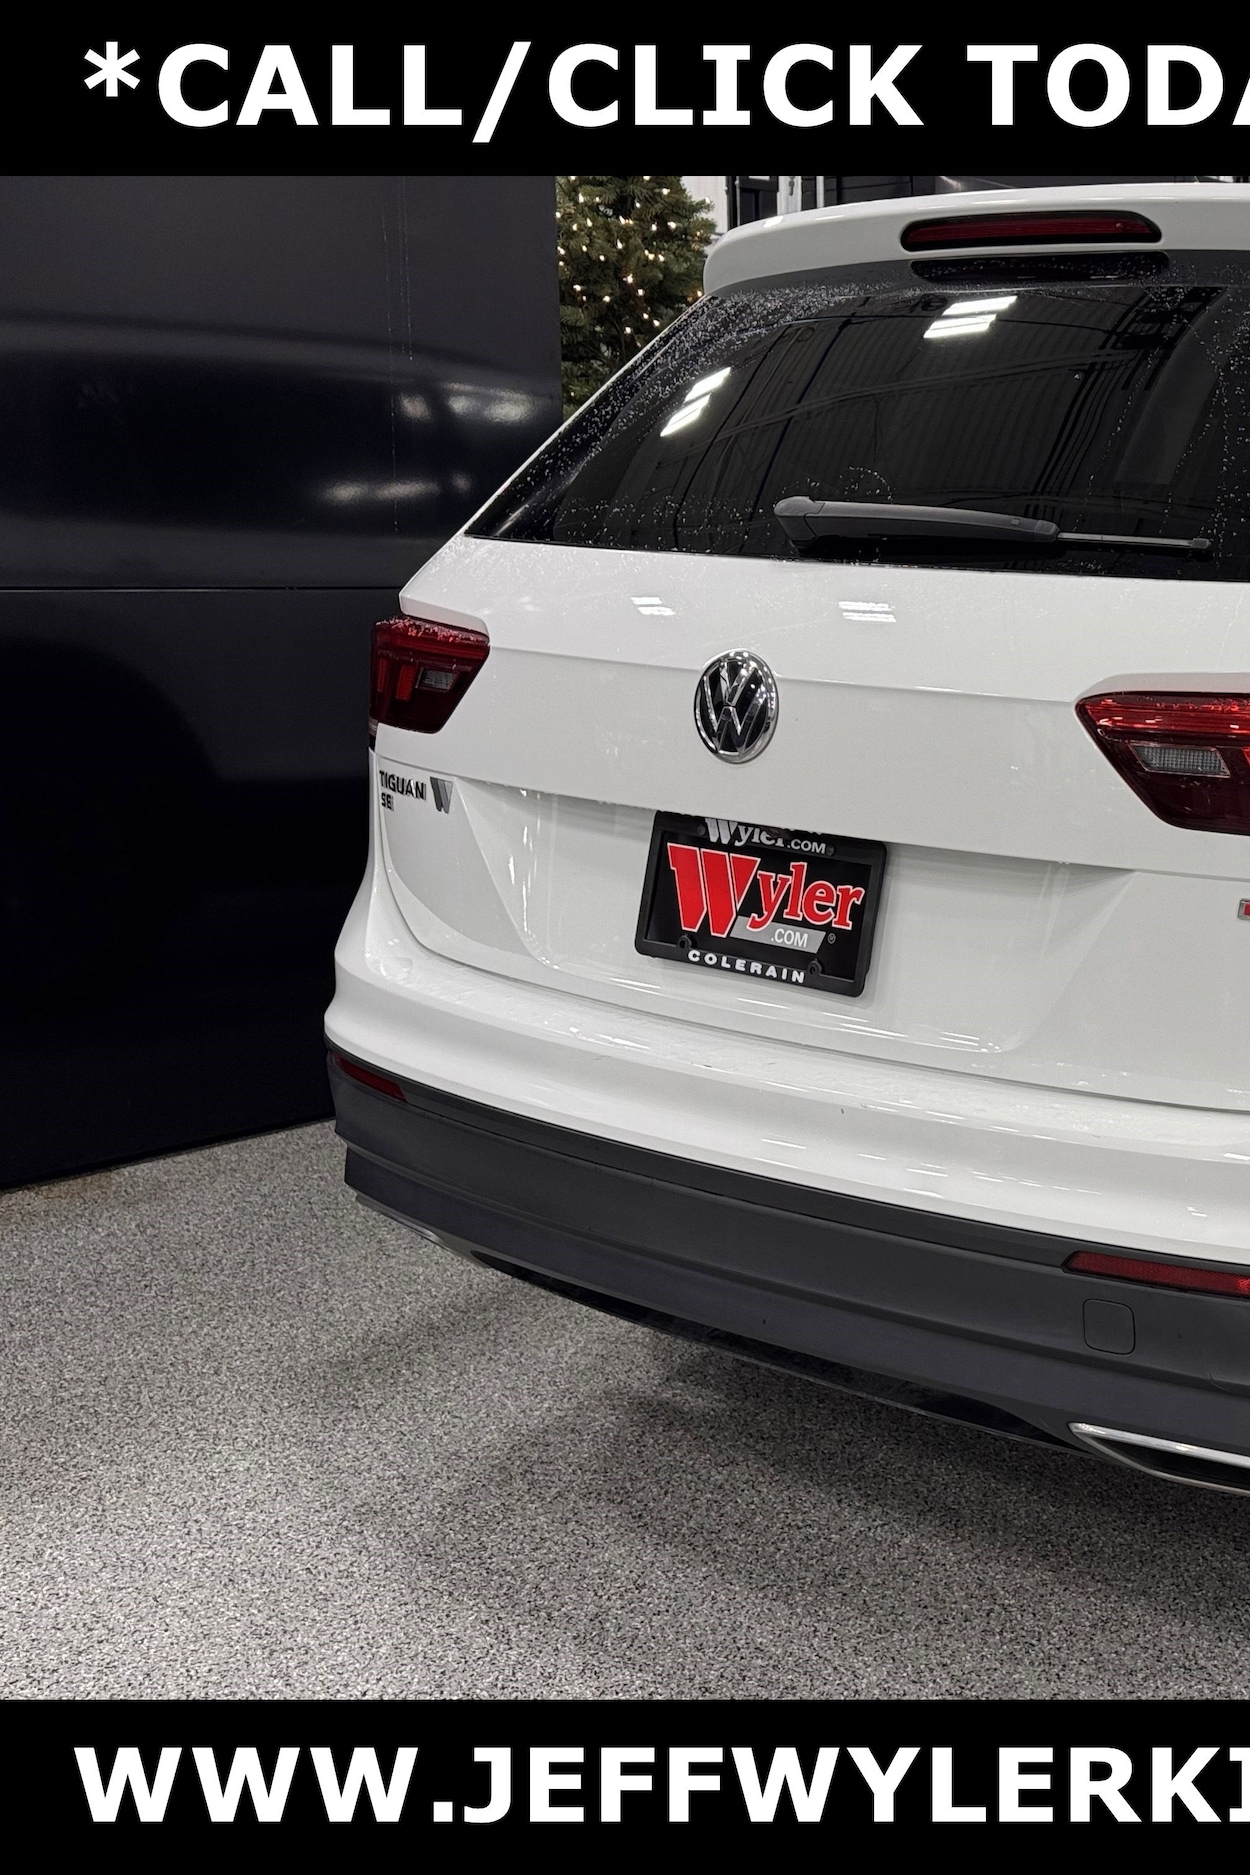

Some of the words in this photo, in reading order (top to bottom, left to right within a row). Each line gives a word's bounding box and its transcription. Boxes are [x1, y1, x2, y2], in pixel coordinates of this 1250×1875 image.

[379, 770, 426, 800] TIGUAN
[381, 792, 394, 811] SE
[667, 842, 865, 938] Wyler
[688, 949, 805, 983] COLERAIN
